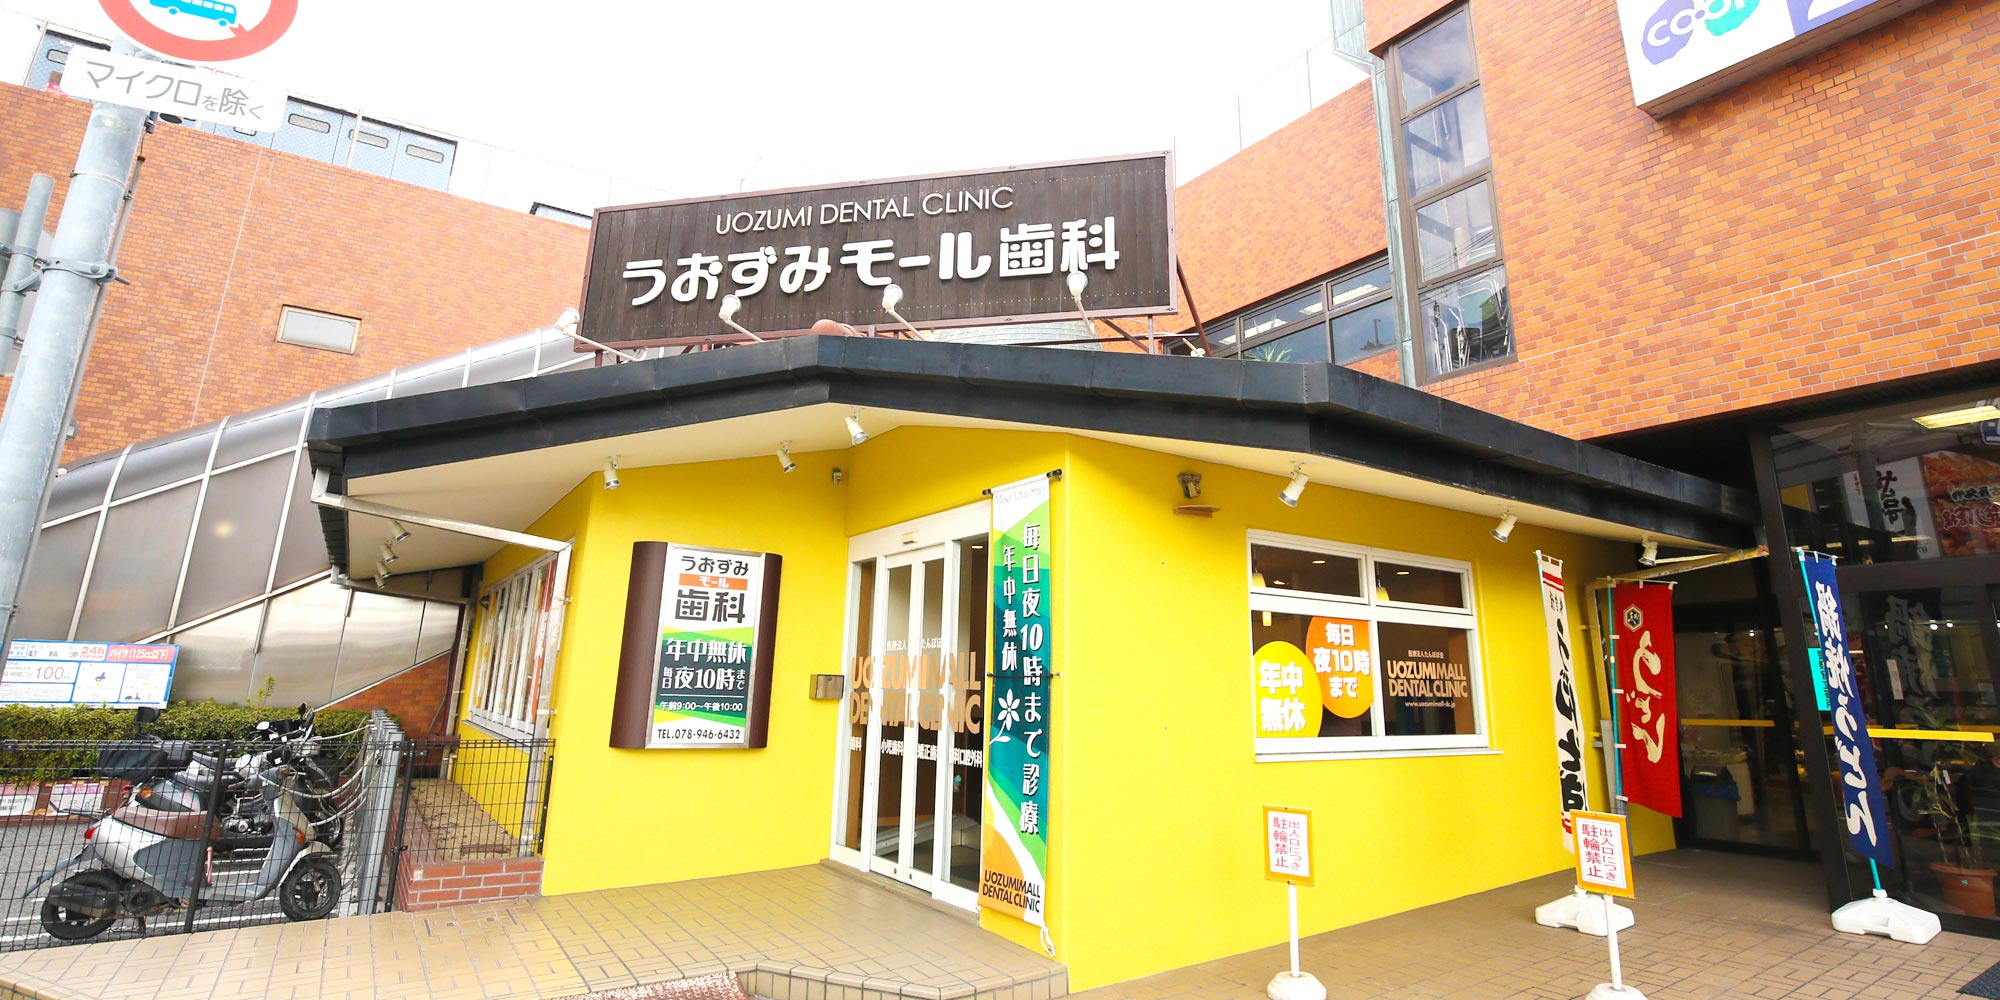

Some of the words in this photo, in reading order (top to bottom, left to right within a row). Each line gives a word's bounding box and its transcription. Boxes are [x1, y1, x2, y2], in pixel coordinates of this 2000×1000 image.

[86, 60, 265, 120] マイクロを除く
[715, 206, 812, 235] UOZUMI
[819, 197, 915, 225] DENTAL
[921, 186, 1014, 216] CLINIC
[621, 216, 1120, 306] うおずみモール歯科
[680, 555, 750, 576] うおずみ
[699, 575, 730, 589] モール
[675, 589, 746, 623] 歯科
[1001, 544, 1018, 672] 年中無休
[81, 646, 105, 655] 24h
[664, 637, 747, 665] 年中無休
[1325, 621, 1355, 647] 毎日
[35, 666, 65, 680] 100
[1018, 522, 1044, 835] 毎日夜10時まで診療
[1258, 660, 1303, 695] 年中
[1313, 647, 1371, 675] 夜10時
[1329, 676, 1359, 699] まで
[1388, 678, 1433, 697] DENTAL
[1433, 680, 1468, 698] CLINIC
[849, 691, 915, 728] DENTAL
[918, 694, 981, 734] CLINIC
[1260, 697, 1306, 732] 無休
[1273, 816, 1289, 868] 駐輪禁止
[1289, 820, 1302, 871] 出入口につき
[1582, 823, 1604, 879] 駐輪禁止
[1599, 827, 1617, 882] 出入口につき
[982, 883, 1014, 906] DENTAL
[1013, 893, 1041, 914] CLINIC
